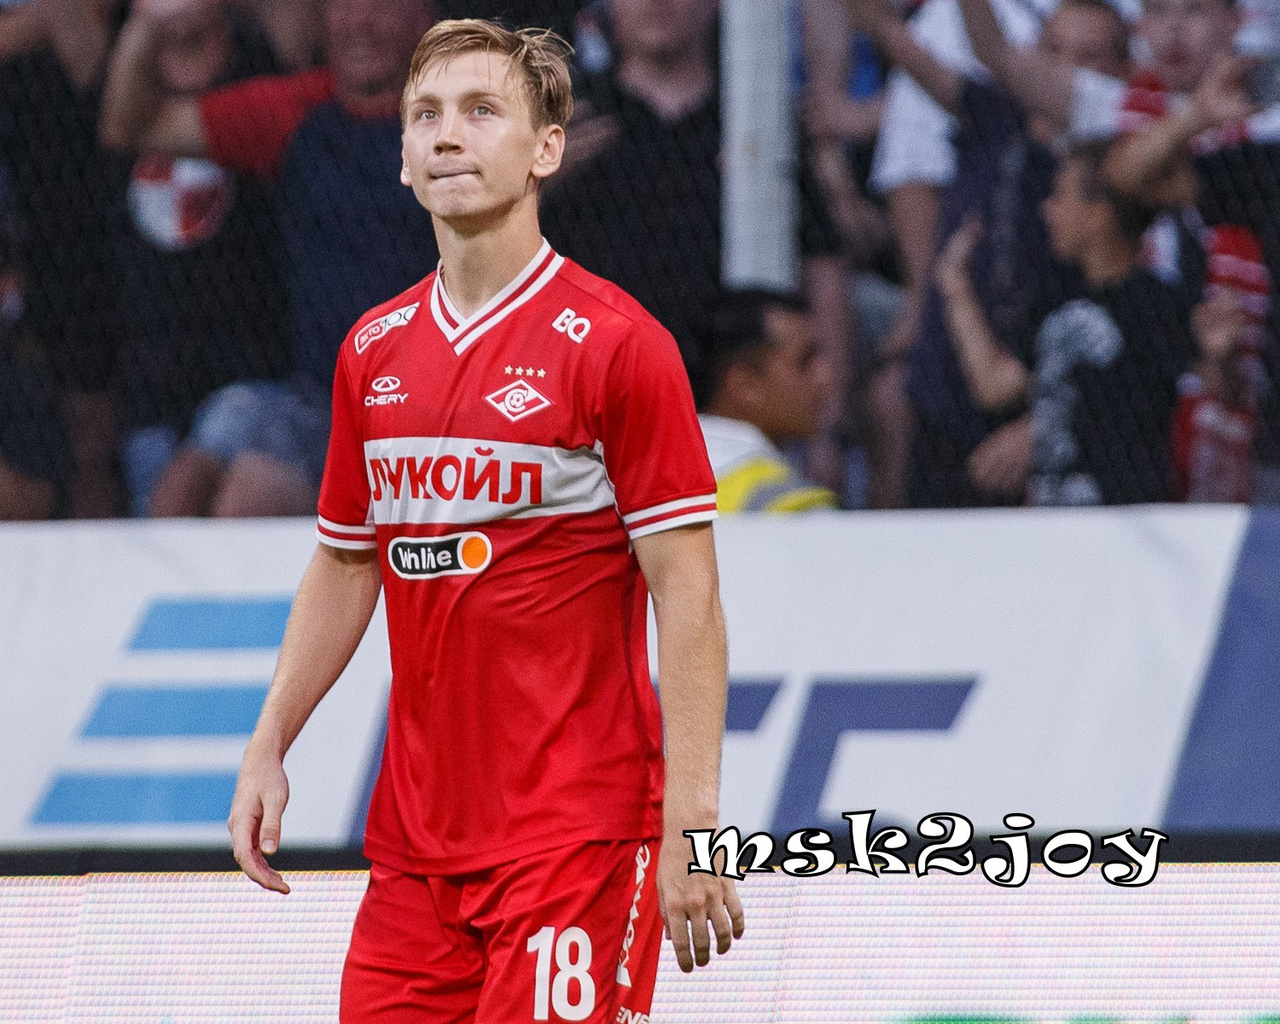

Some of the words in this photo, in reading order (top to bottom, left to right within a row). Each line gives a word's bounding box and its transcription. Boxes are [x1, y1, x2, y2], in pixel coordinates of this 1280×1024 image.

[551, 307, 591, 344] BQ
[364, 392, 409, 407] CHERY
[369, 446, 543, 505] ЛУКОЙЛ
[526, 925, 597, 1022] 18
